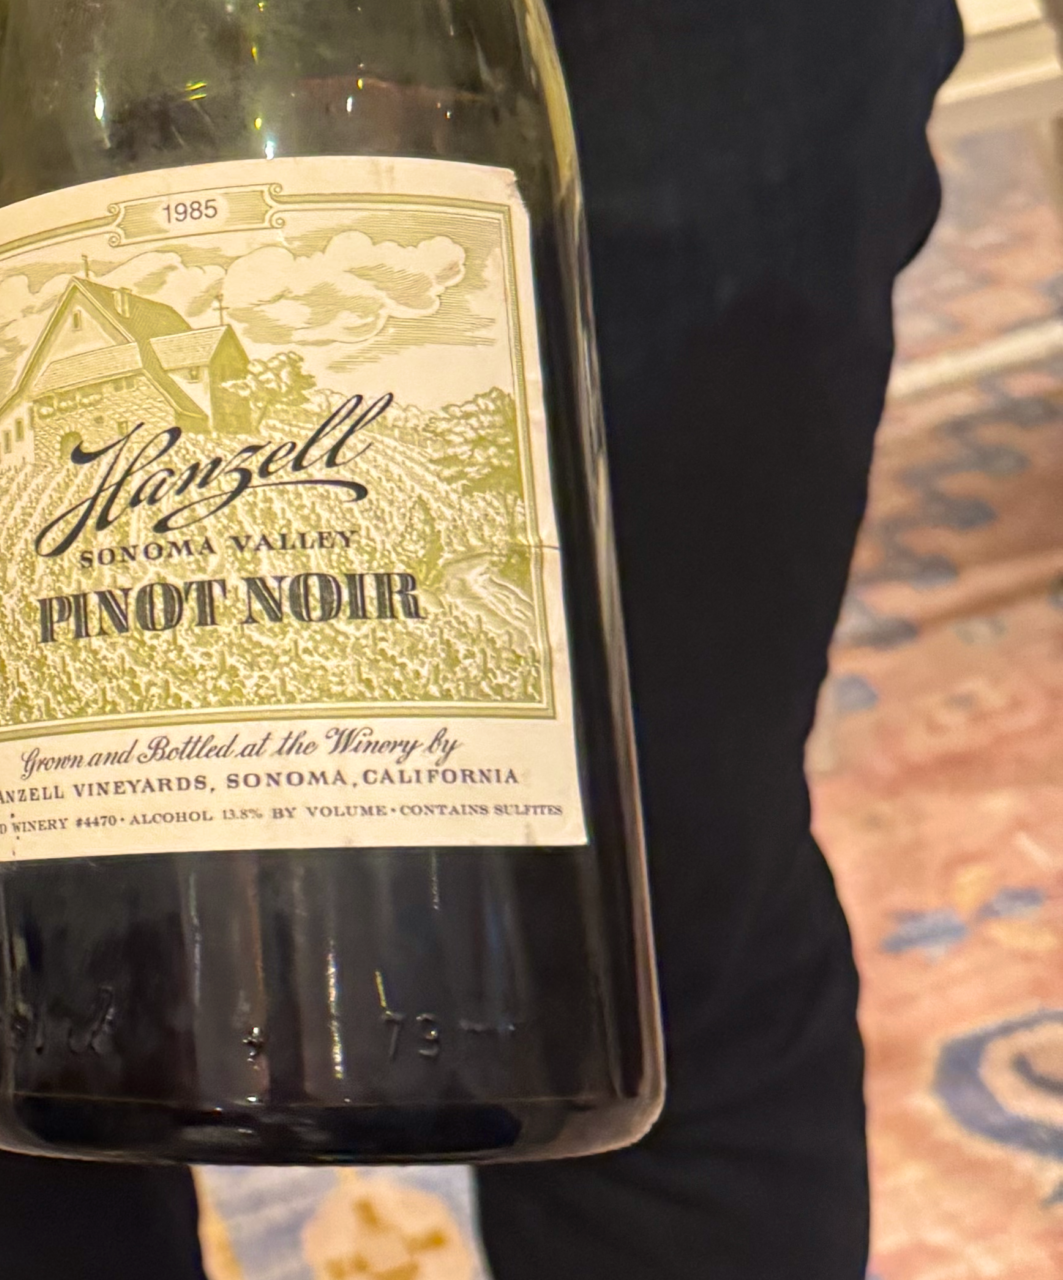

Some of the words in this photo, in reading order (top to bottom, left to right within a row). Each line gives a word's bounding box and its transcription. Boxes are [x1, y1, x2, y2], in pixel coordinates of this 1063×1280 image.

[163, 198, 218, 224] 1985
[35, 392, 393, 557] Hanzell
[79, 536, 216, 569] SONOMA
[229, 530, 358, 552] VALLEY
[37, 578, 228, 645] PINOT
[241, 571, 427, 625] NOIR
[21, 747, 84, 781] Grown
[86, 738, 139, 768] and
[138, 733, 239, 764] Bottled
[237, 731, 268, 759] at
[275, 729, 318, 757] the
[325, 727, 422, 765] Winery
[425, 726, 463, 767] by
[73, 774, 216, 798] VINEYARDS,
[226, 769, 358, 789] SONOMA,
[362, 768, 519, 786] CALIFORNIA
[12, 817, 68, 833] WINERY
[75, 815, 117, 828] #4470
[129, 809, 214, 826] ALCOHOL
[221, 807, 263, 821] 13.8%
[272, 806, 297, 820] BY
[305, 805, 388, 818] VOLUME
[399, 804, 489, 817] CONTAINS
[494, 804, 563, 816] SULFITES
